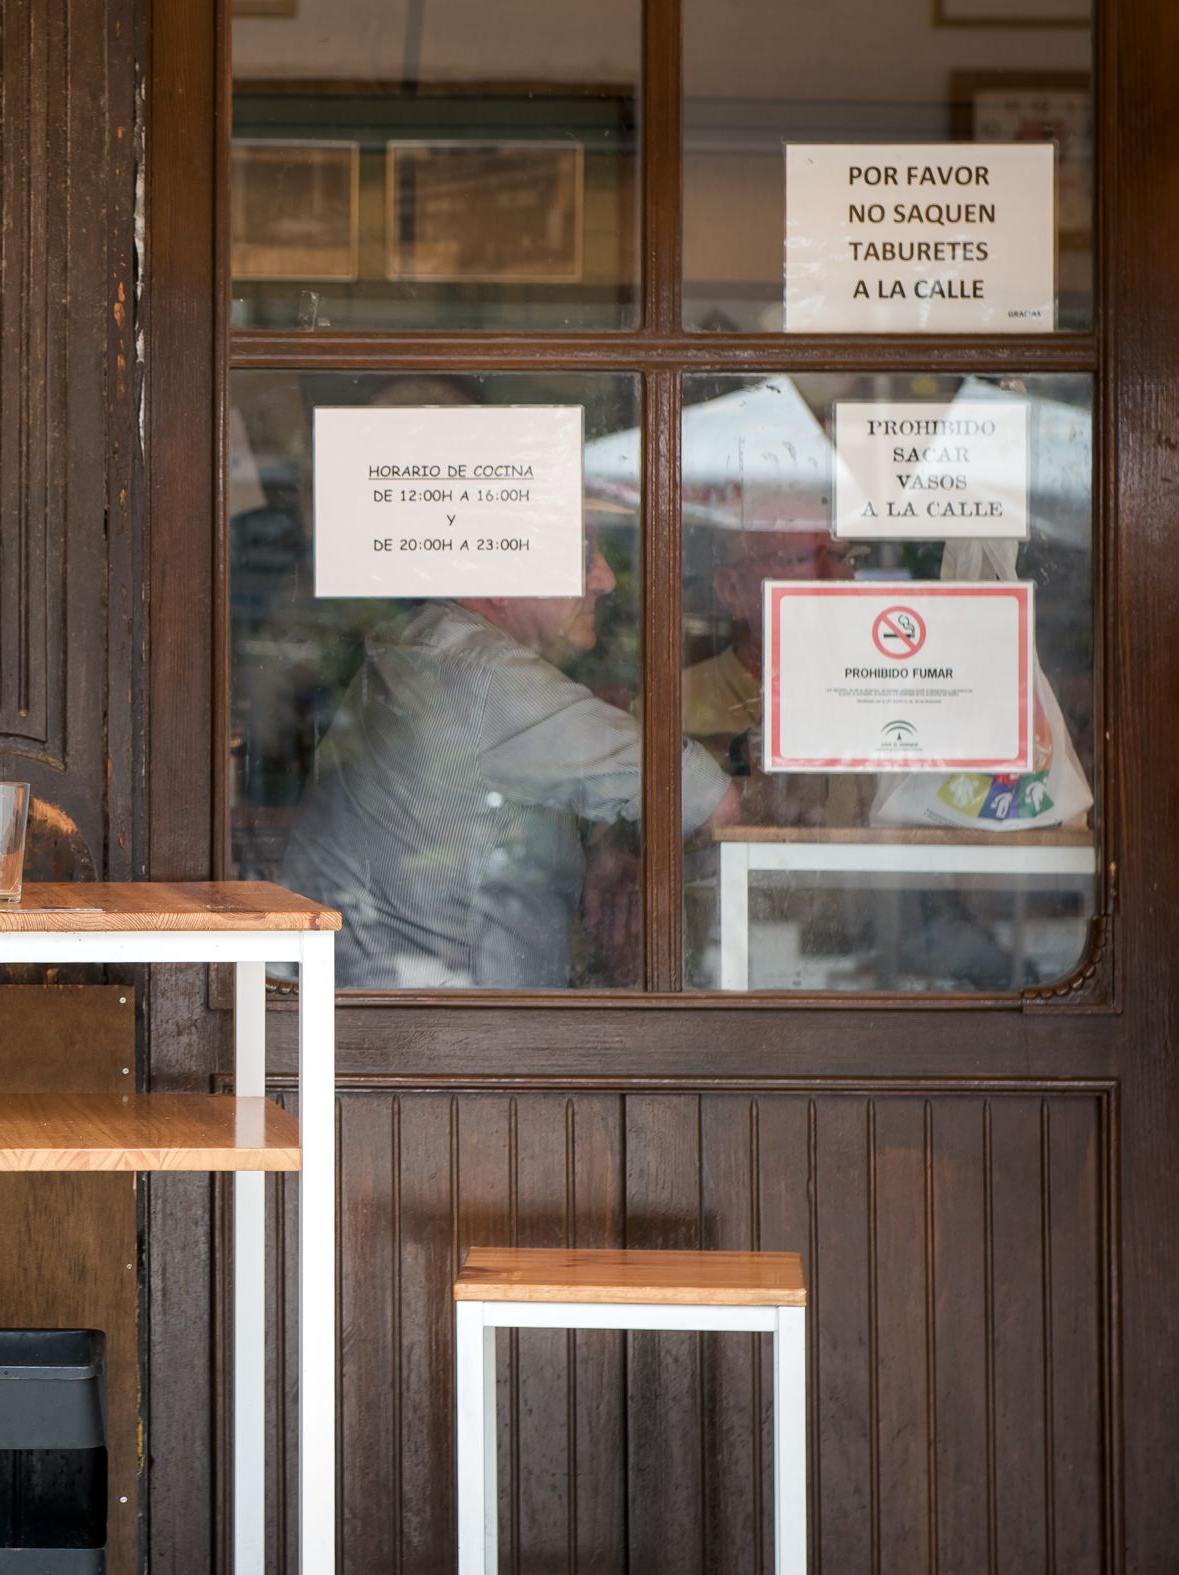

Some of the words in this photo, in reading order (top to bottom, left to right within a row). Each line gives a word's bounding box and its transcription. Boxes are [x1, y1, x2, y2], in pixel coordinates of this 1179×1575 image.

[849, 166, 898, 185] POR
[907, 166, 989, 185] FAVOR
[849, 204, 885, 223] NO
[894, 204, 995, 226] SAQUEN
[848, 241, 988, 261] TABURETES
[853, 280, 870, 299] A
[878, 280, 906, 299] LA
[914, 280, 984, 299] CALLE
[867, 420, 995, 436] PROHIBIDO
[893, 447, 969, 463] SACAR
[369, 465, 440, 478] HORARIO
[448, 465, 467, 478] DE
[473, 465, 533, 478] COCINA
[896, 474, 967, 490] VASOS
[374, 489, 392, 502] DE
[401, 489, 452, 502] 12:00H
[460, 490, 469, 501] A
[478, 489, 529, 502] 16:00H
[861, 501, 879, 517] A
[887, 502, 917, 517] LA
[927, 502, 1002, 517] CALLE
[447, 514, 456, 526] Y
[374, 539, 392, 551] DE
[400, 539, 452, 551] 20:00H
[460, 540, 469, 551] A
[477, 538, 529, 551] 23:00H
[845, 668, 908, 679] PROHIBIDO
[913, 668, 953, 679] FUMAR
